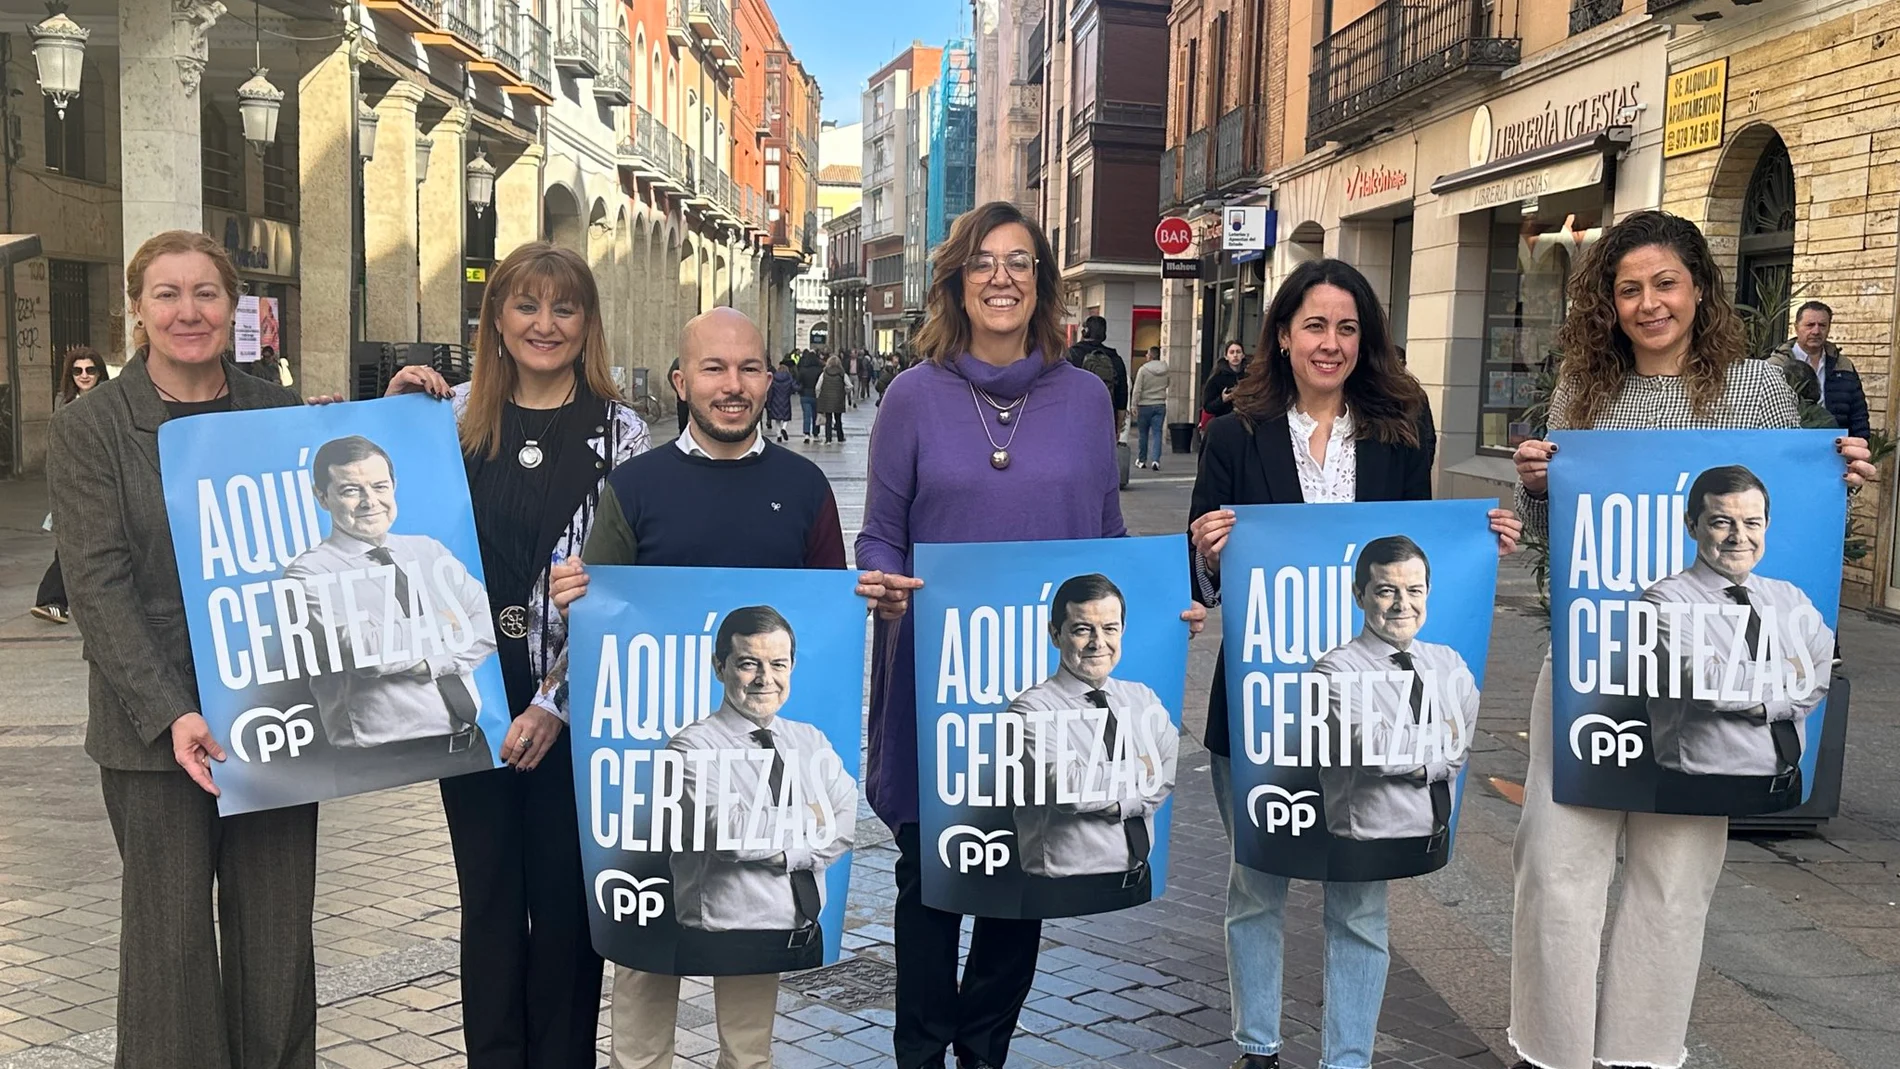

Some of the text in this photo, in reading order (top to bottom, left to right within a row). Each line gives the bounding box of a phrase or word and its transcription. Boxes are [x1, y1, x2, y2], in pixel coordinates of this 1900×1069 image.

[1495, 81, 1640, 160] LIBRERÍA IGLESIAS
[1668, 92, 1721, 125] APARTAMENTOS
[1674, 66, 1719, 98] SE ALQUILAN
[1676, 125, 1688, 149] 979
[1689, 124, 1698, 146] 74
[1160, 229, 1189, 244] BAR
[1473, 172, 1550, 207] LIBRERÍA IGLESIAS
[1166, 261, 1197, 271] Mahou
[198, 447, 322, 580] AQUÍ
[1569, 472, 1690, 592] AQUÍ
[207, 554, 476, 690] CERTEZAS
[936, 582, 1053, 705] AQUÍ
[1242, 543, 1356, 664] AQUÍ
[1568, 597, 1820, 701] CERTEZAS
[590, 611, 717, 741] AQUÍ
[1242, 667, 1469, 768] CERTEZAS
[590, 747, 838, 852] CERTEZAS
[936, 703, 1168, 808] CERTEZAS
